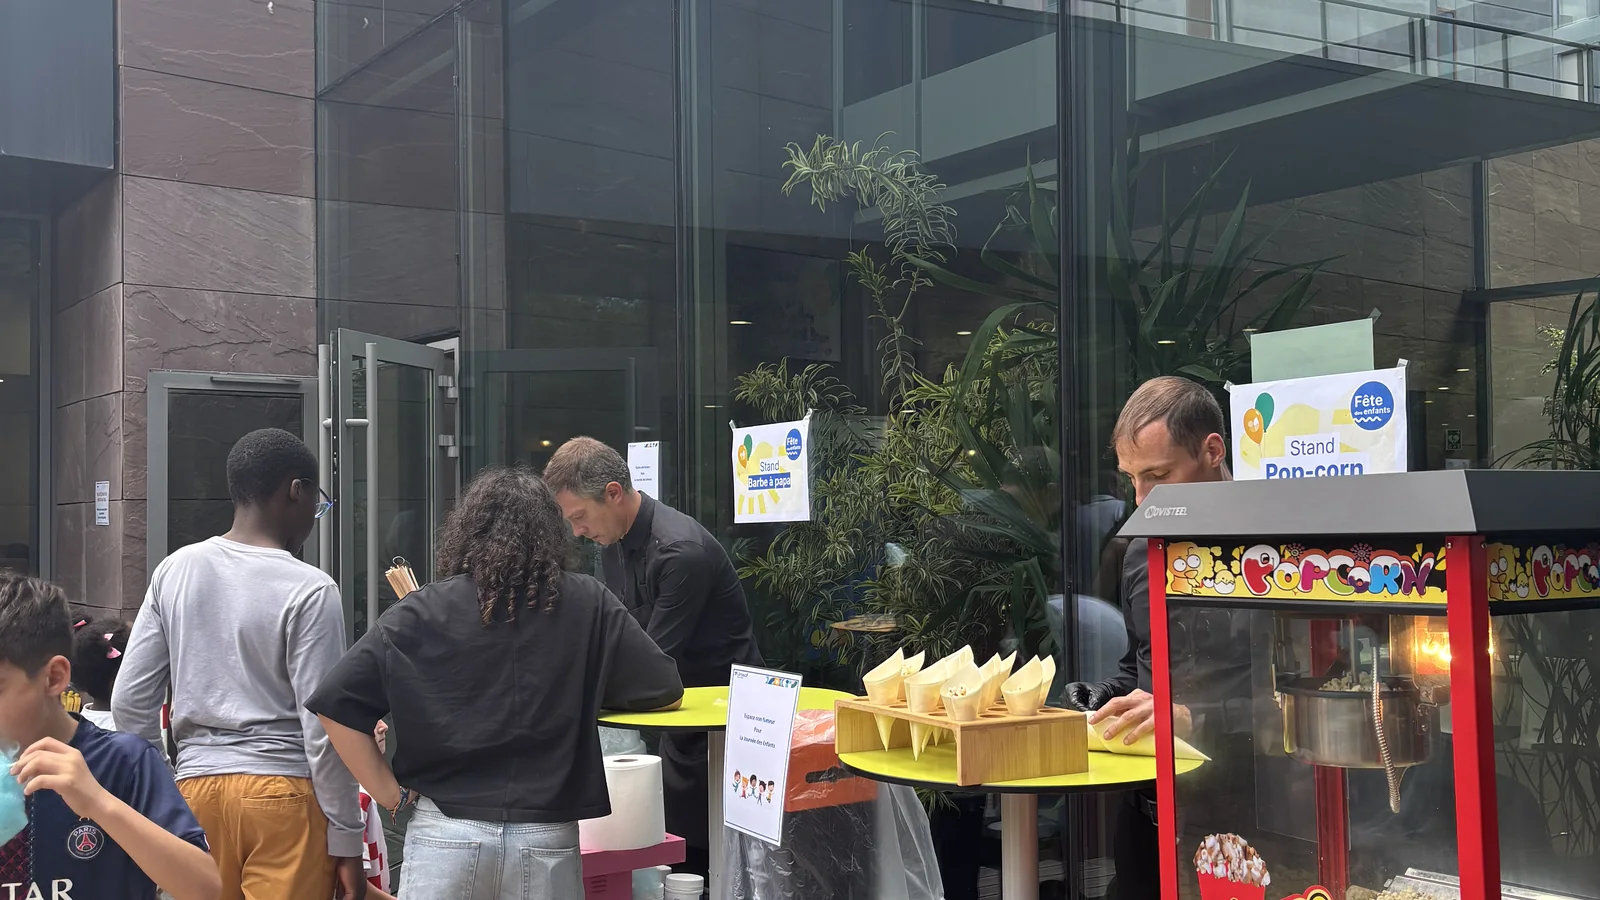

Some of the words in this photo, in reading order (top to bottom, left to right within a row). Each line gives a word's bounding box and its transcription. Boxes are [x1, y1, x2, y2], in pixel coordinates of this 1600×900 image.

[1354, 394, 1383, 408] Fête
[1363, 407, 1391, 415] enfants
[787, 437, 798, 446] Fête
[1290, 437, 1335, 456] Stand
[760, 461, 780, 472] Stand
[1265, 462, 1364, 479] Pop-corn
[748, 477, 768, 488] Barbe
[769, 476, 774, 486] à
[774, 477, 791, 489] papa
[1144, 505, 1188, 519] NOVISTEEL
[1240, 544, 1435, 597] POPCORN
[1532, 544, 1600, 597] POPCO
[73, 827, 97, 837] PARIS
[1, 878, 74, 900] TAR
